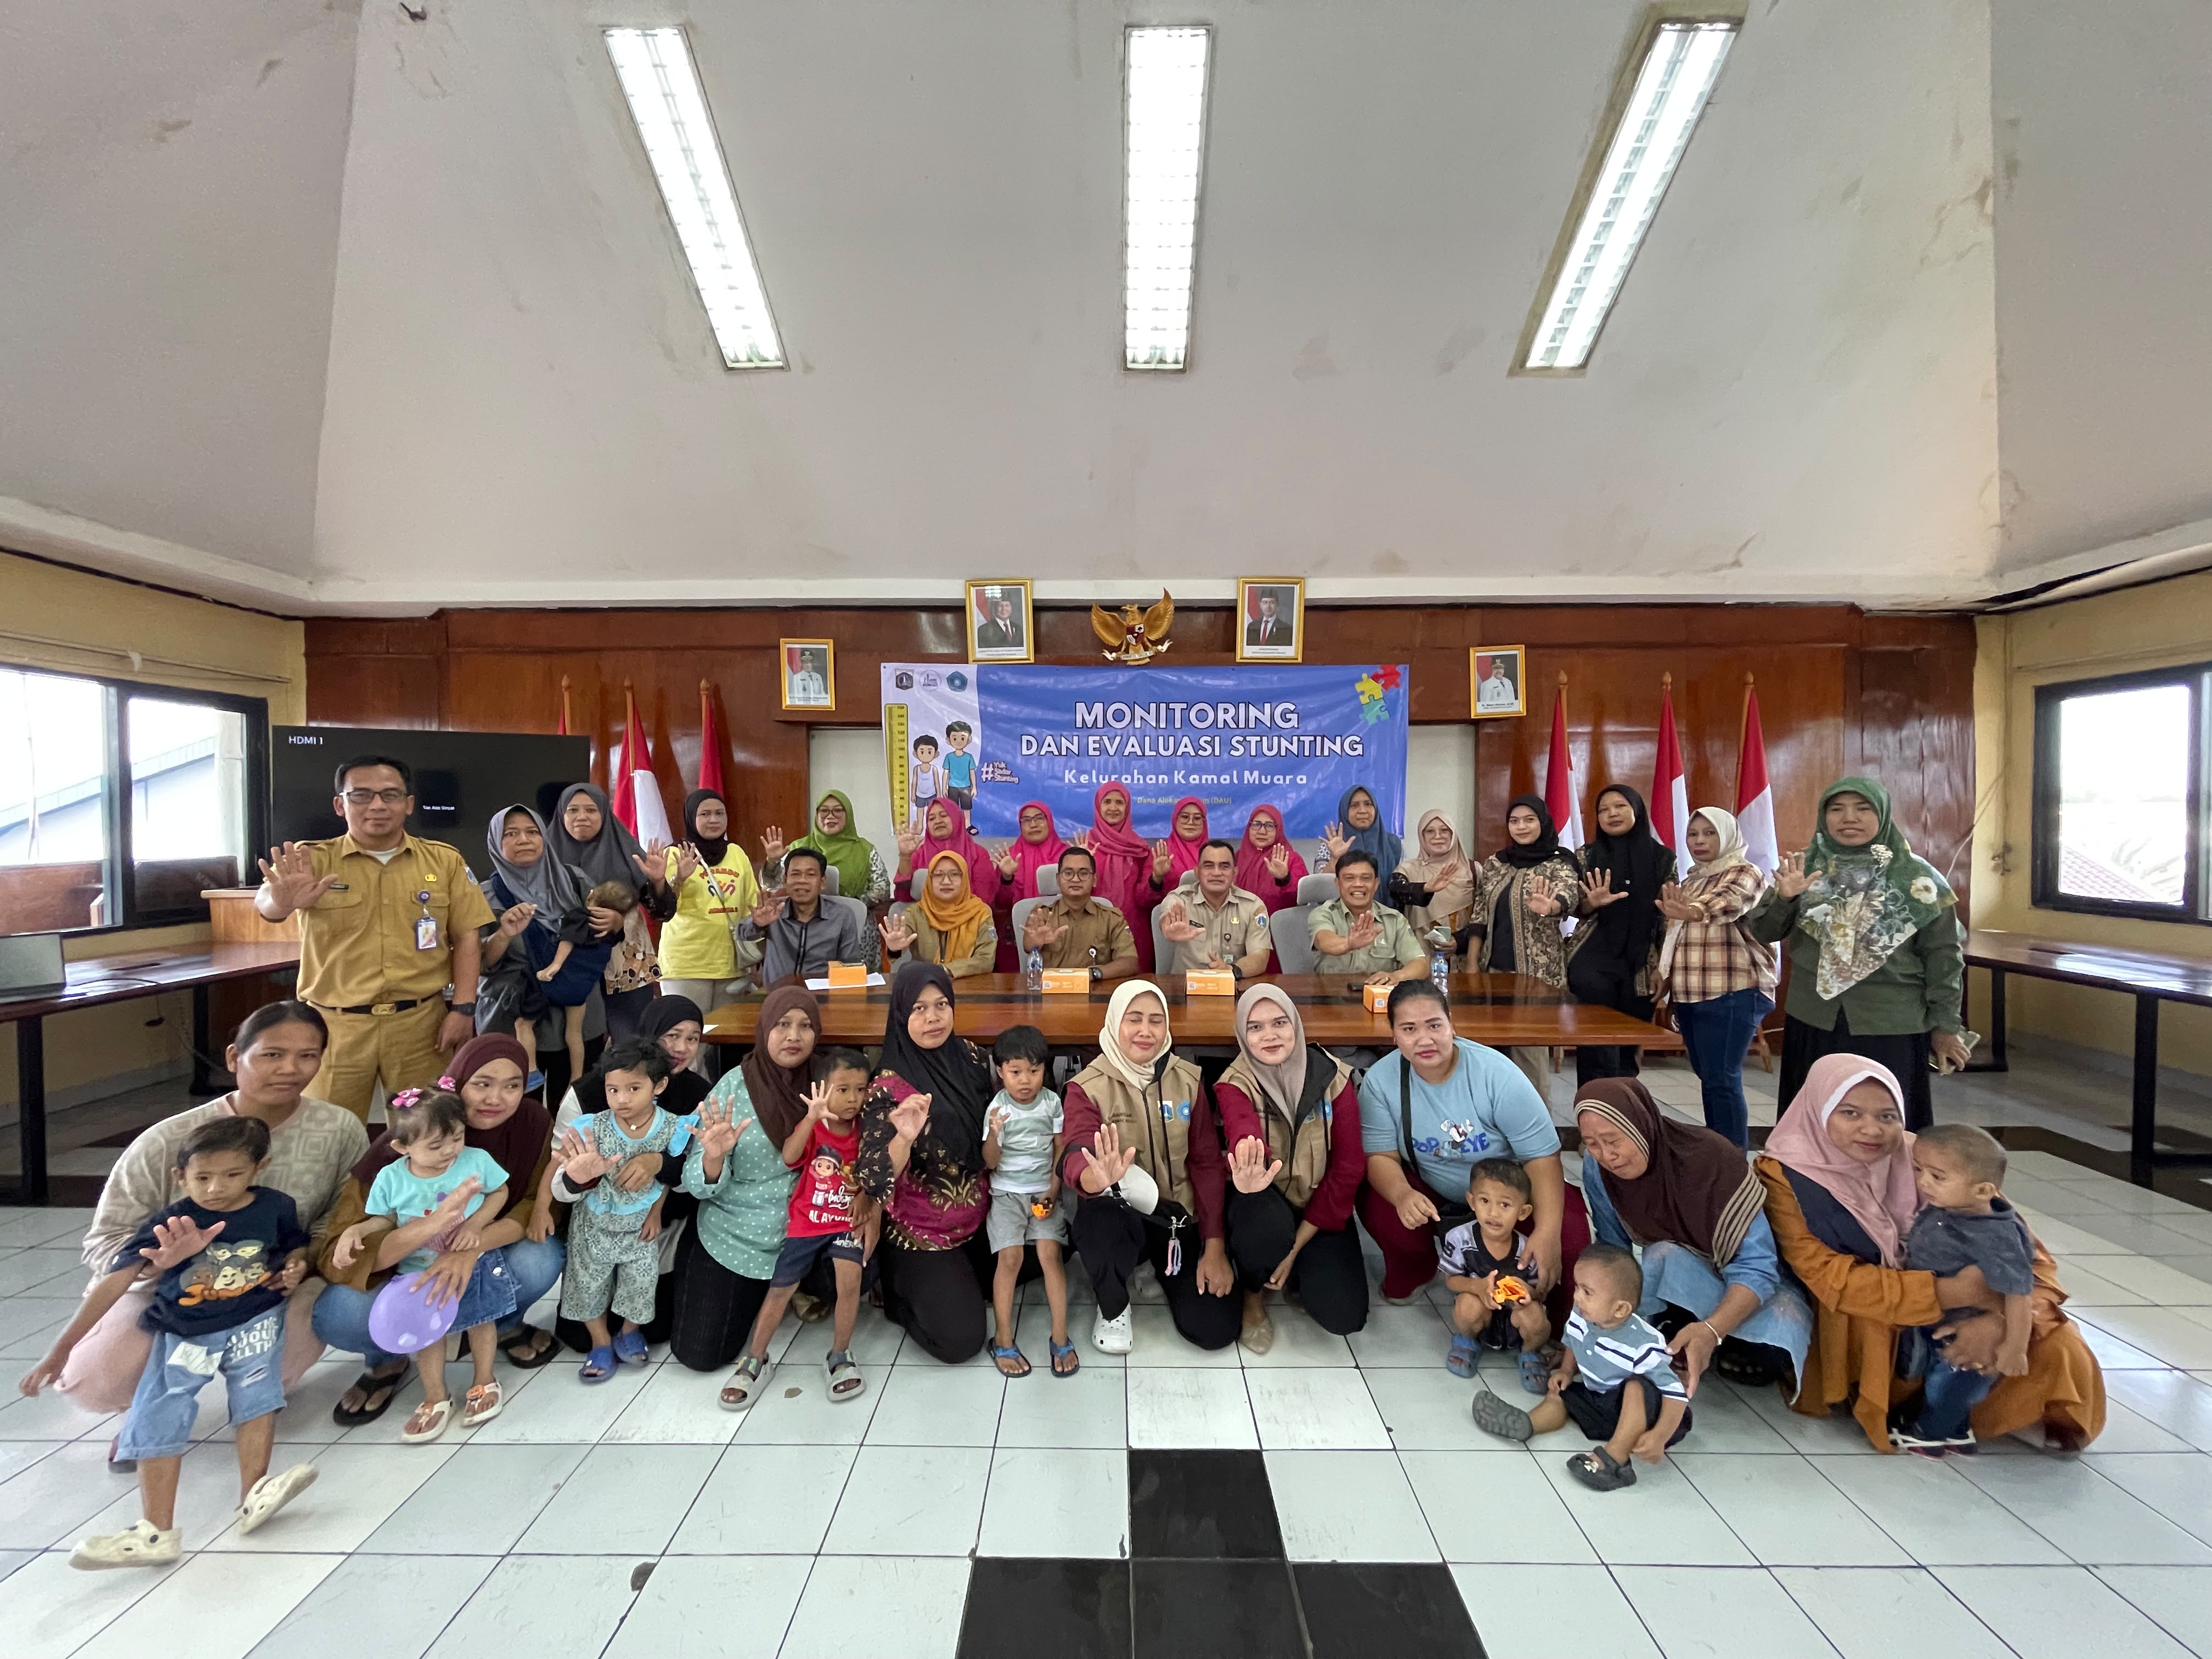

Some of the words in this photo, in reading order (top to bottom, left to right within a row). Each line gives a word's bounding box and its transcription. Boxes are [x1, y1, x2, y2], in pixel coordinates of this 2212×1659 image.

[1075, 702, 1299, 729] MONITORING
[289, 736, 317, 744] HDMI
[319, 737, 323, 745] 1
[1021, 734, 1079, 757] DAN
[1087, 735, 1221, 757] EVALUASI
[1229, 735, 1364, 757] STUNTING
[1064, 769, 1169, 784] Kelurahan
[1174, 770, 1238, 784] Kamal
[1244, 770, 1307, 784] Muara
